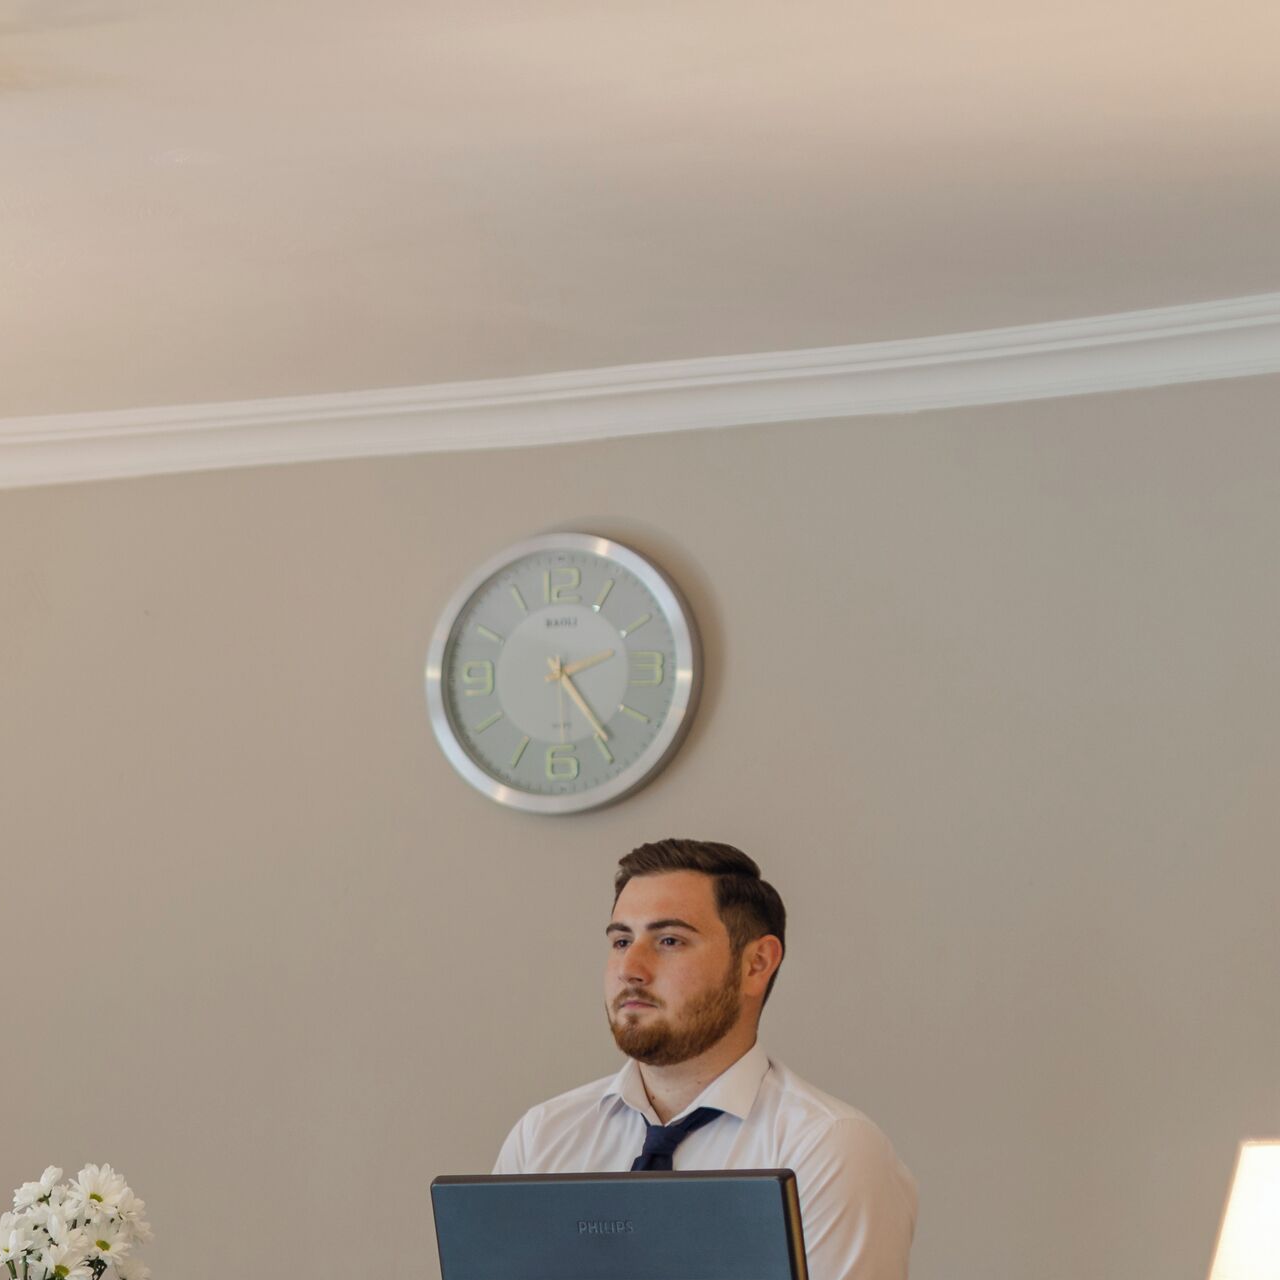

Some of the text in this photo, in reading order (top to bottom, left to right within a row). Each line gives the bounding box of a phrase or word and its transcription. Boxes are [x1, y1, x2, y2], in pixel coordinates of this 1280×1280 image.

[543, 566, 582, 604] 12
[462, 659, 495, 697] 9
[628, 650, 664, 686] 3
[545, 743, 580, 782] 6
[576, 1219, 634, 1234] PHILIPS
